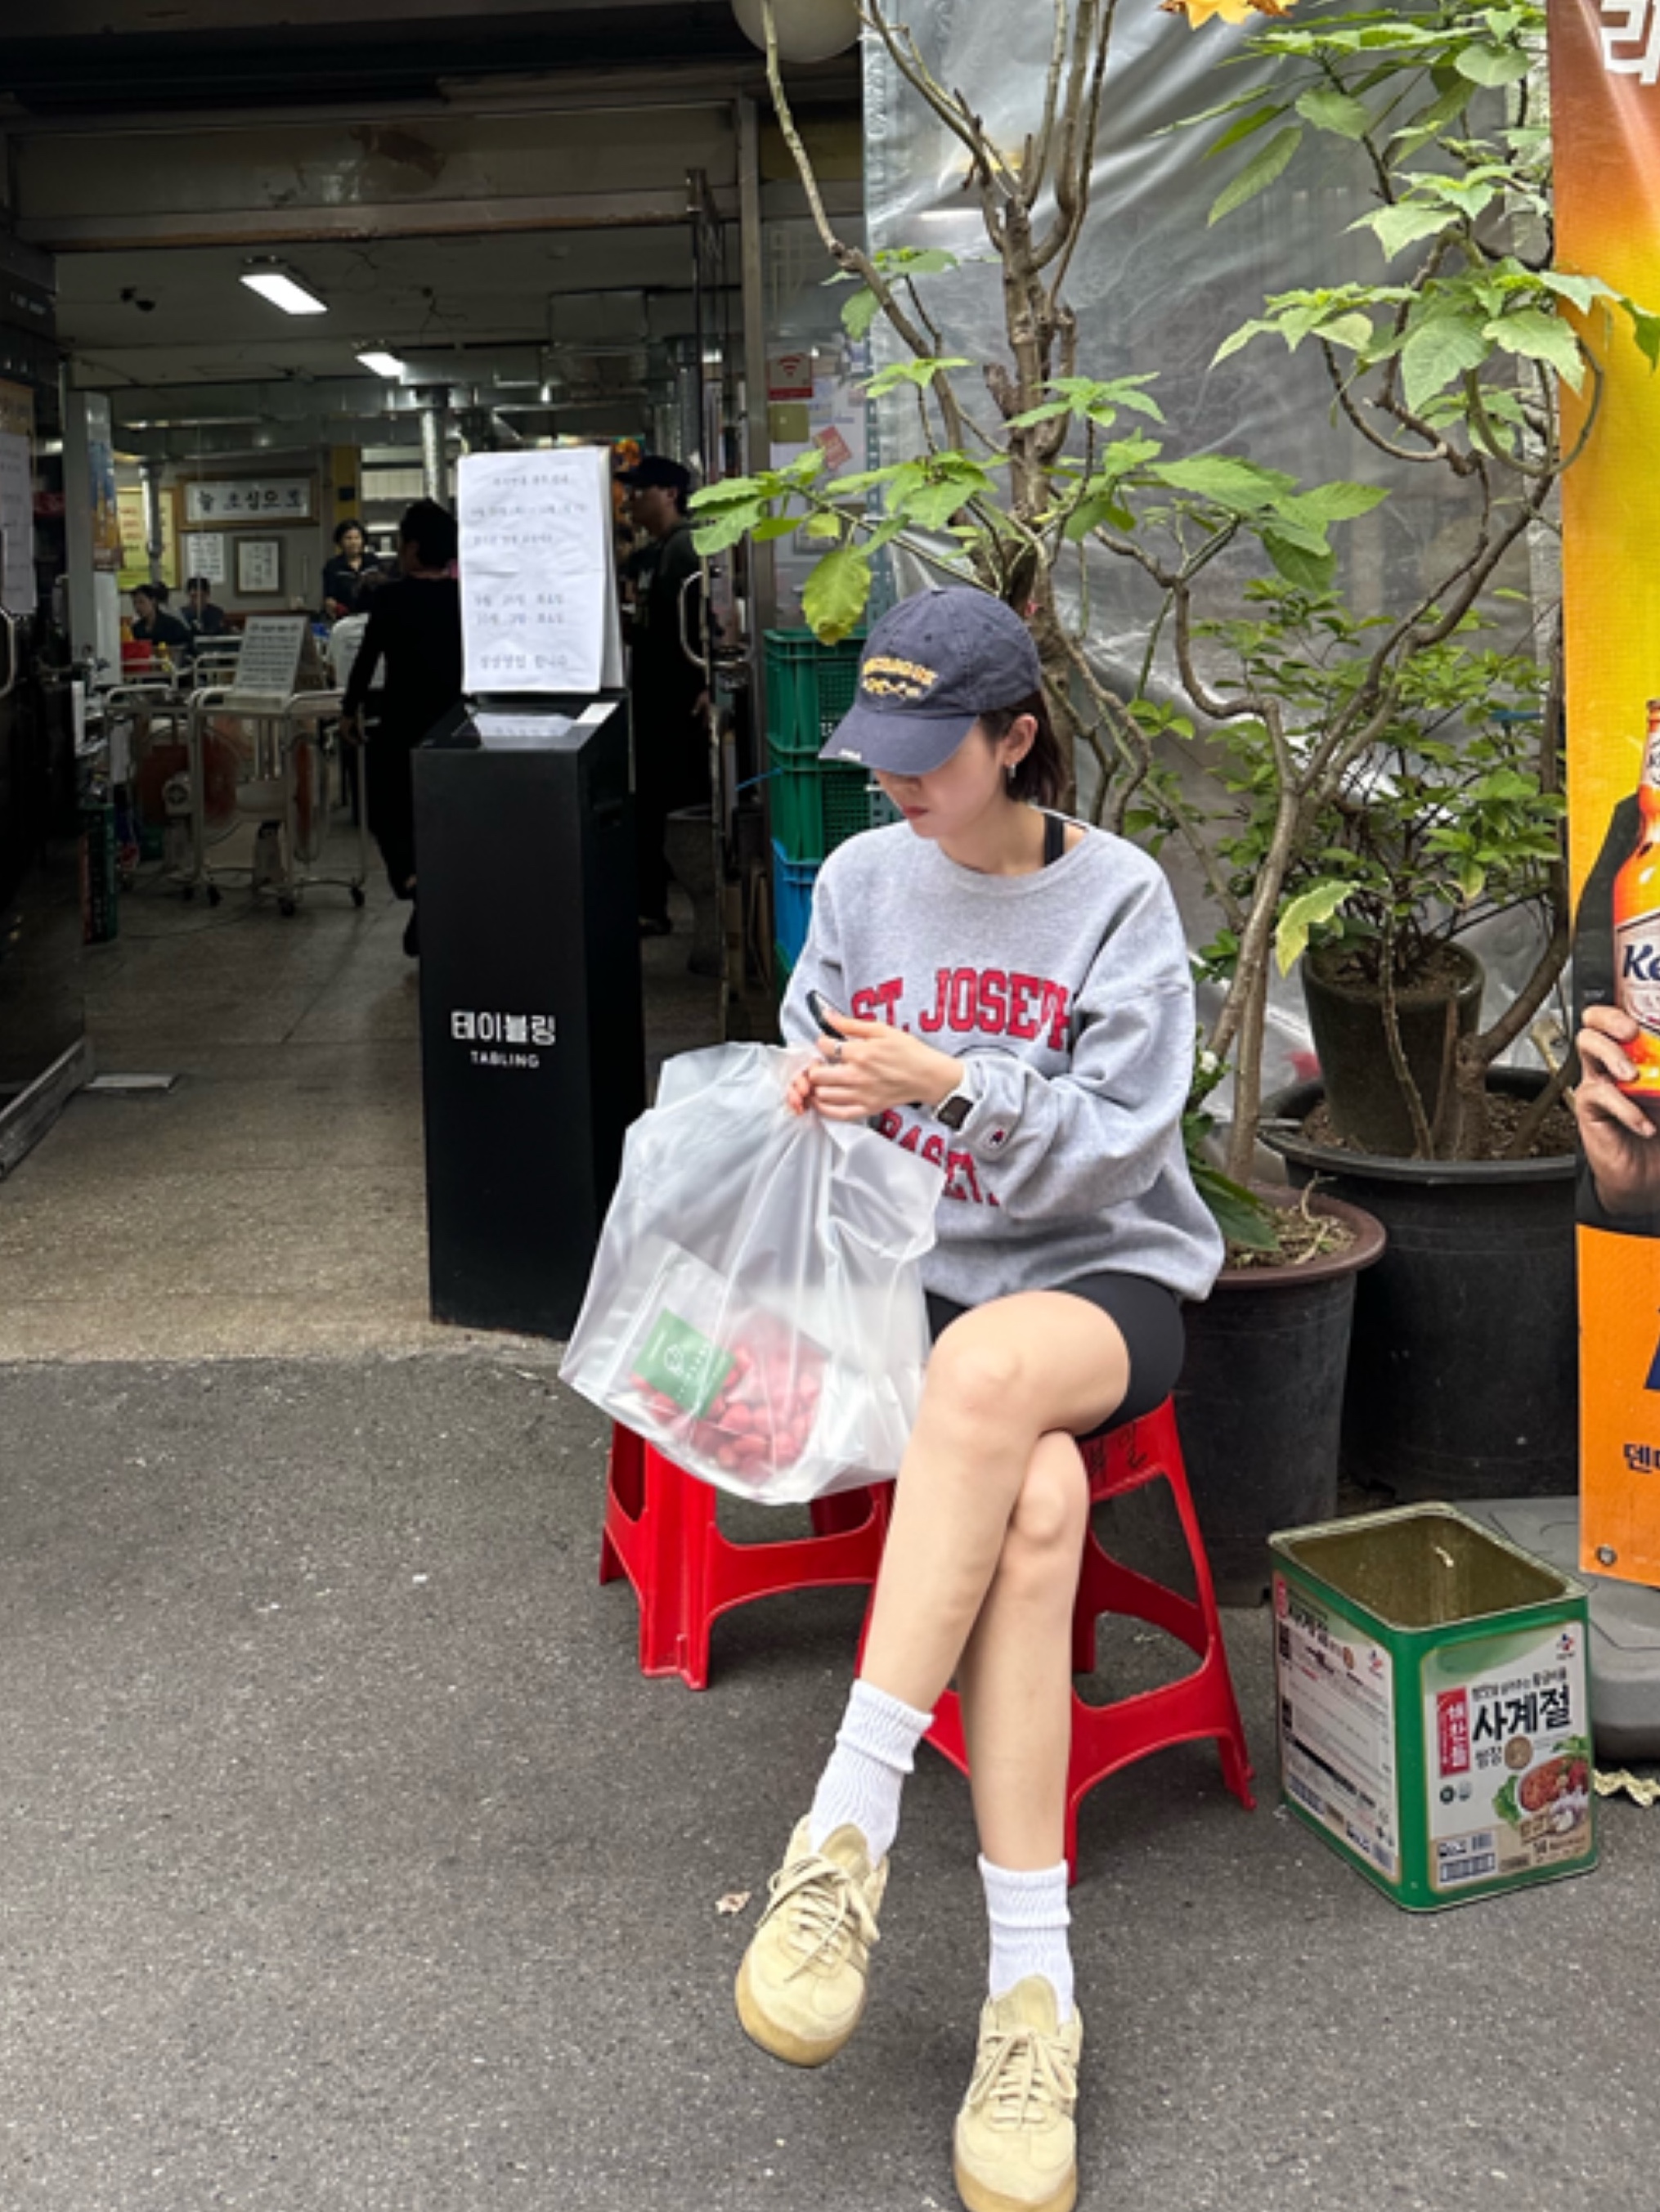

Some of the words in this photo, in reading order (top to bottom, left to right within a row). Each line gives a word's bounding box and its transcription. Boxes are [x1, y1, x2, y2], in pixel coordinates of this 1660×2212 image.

[451, 1011, 556, 1046] 테이블링
[470, 1051, 540, 1069] TABLING
[1473, 1685, 1572, 1742] 사계절
